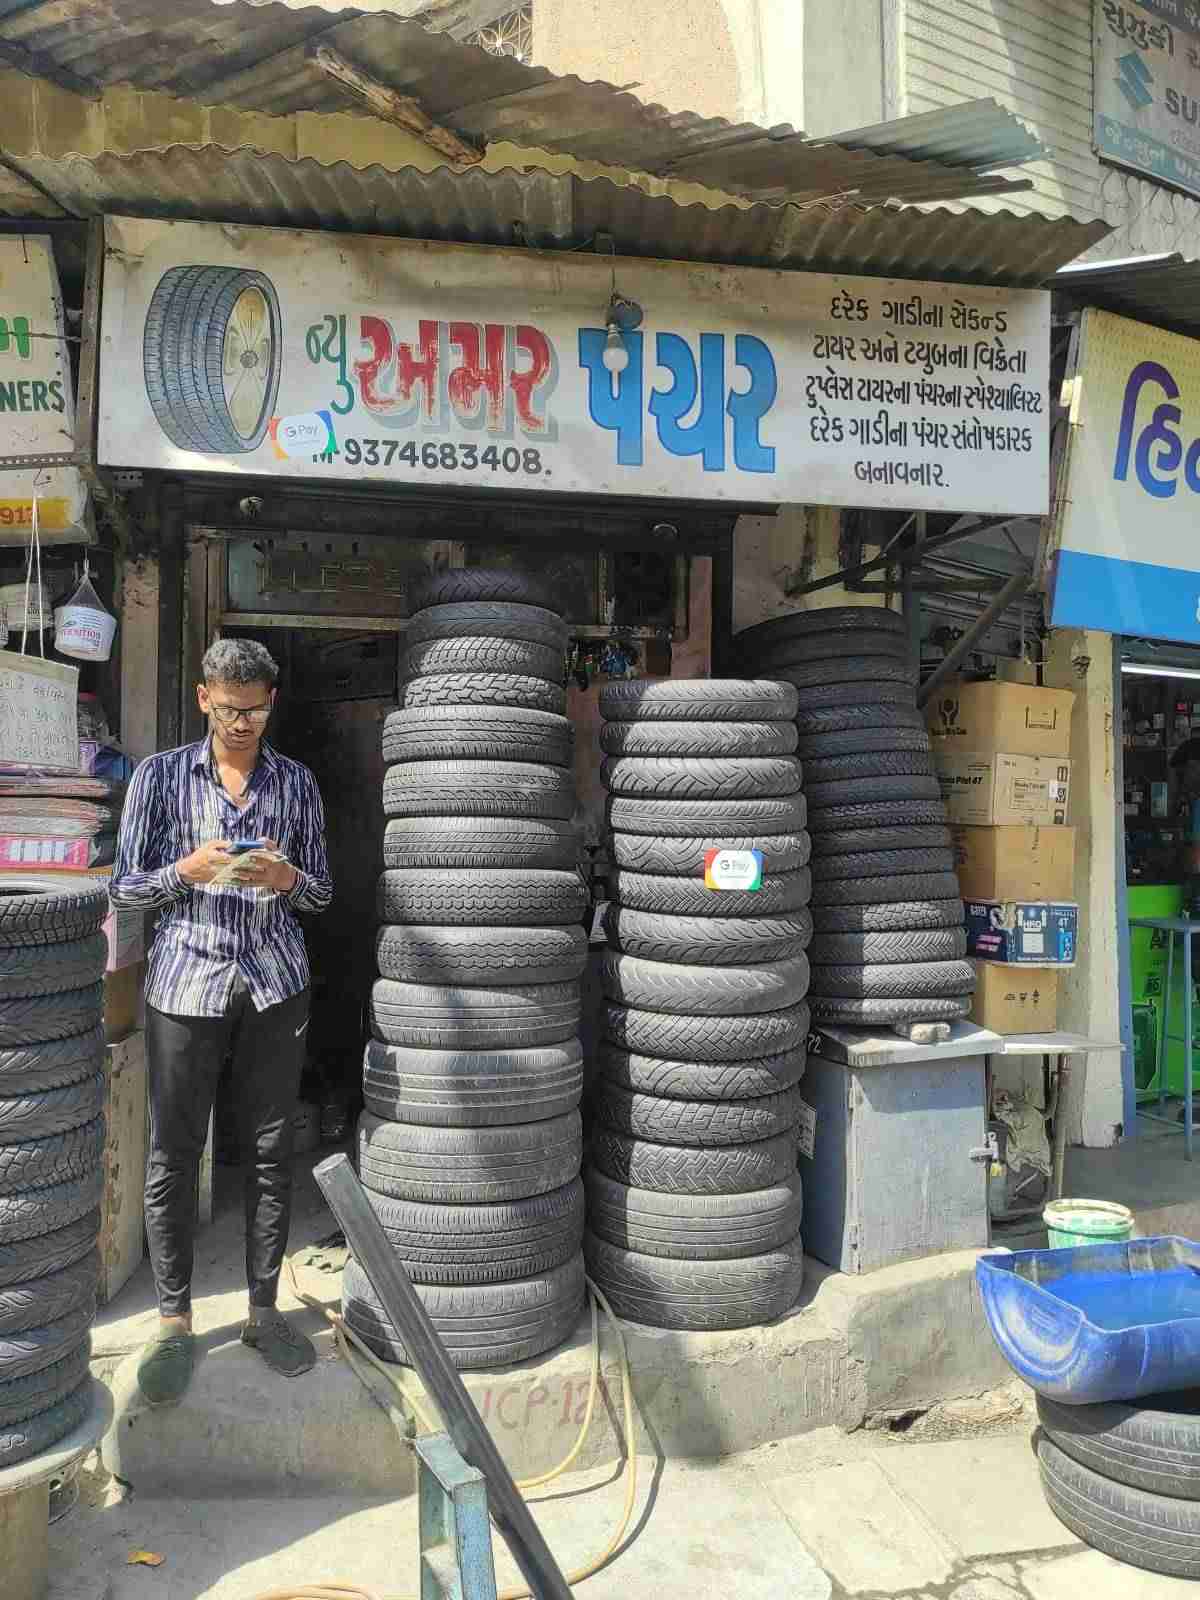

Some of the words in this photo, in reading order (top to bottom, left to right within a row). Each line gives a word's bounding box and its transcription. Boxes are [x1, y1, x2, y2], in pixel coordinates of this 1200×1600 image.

[830, 289, 869, 322] દરેક
[881, 296, 944, 329] ગાડીના
[813, 334, 857, 361] ટાયર
[860, 331, 899, 364] અને
[352, 315, 557, 441] અમર
[578, 301, 778, 474] પંચર
[857, 377, 911, 405] ટાયરના
[914, 378, 962, 408] પંચરના
[810, 405, 845, 443] દરેક
[849, 409, 908, 448] ગાડીના
[912, 416, 949, 449] પંચર
[951, 416, 1033, 452] સંતોષકારક
